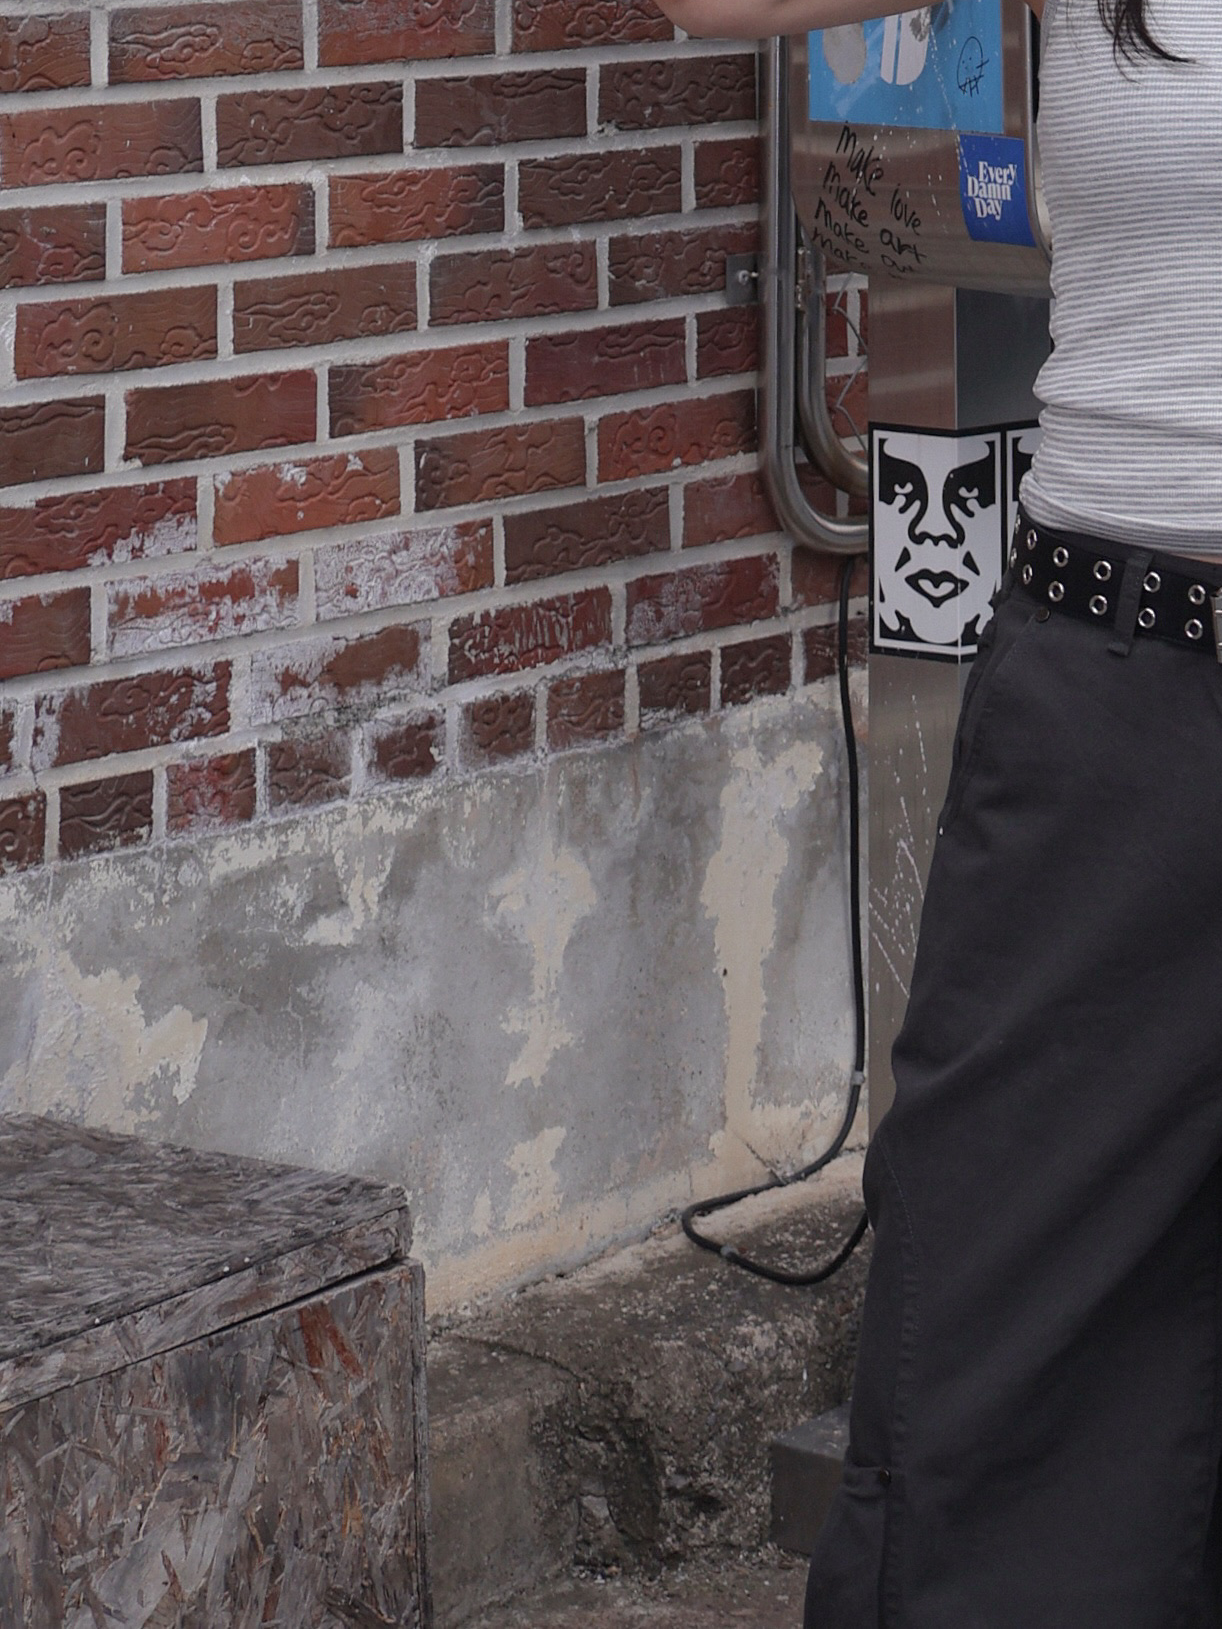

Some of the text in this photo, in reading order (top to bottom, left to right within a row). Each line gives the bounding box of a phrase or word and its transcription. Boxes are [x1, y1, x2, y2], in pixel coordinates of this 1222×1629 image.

[977, 160, 1018, 186] Every
[966, 176, 1012, 201] Damn
[974, 196, 1003, 220] Day
[879, 228, 927, 264] art
